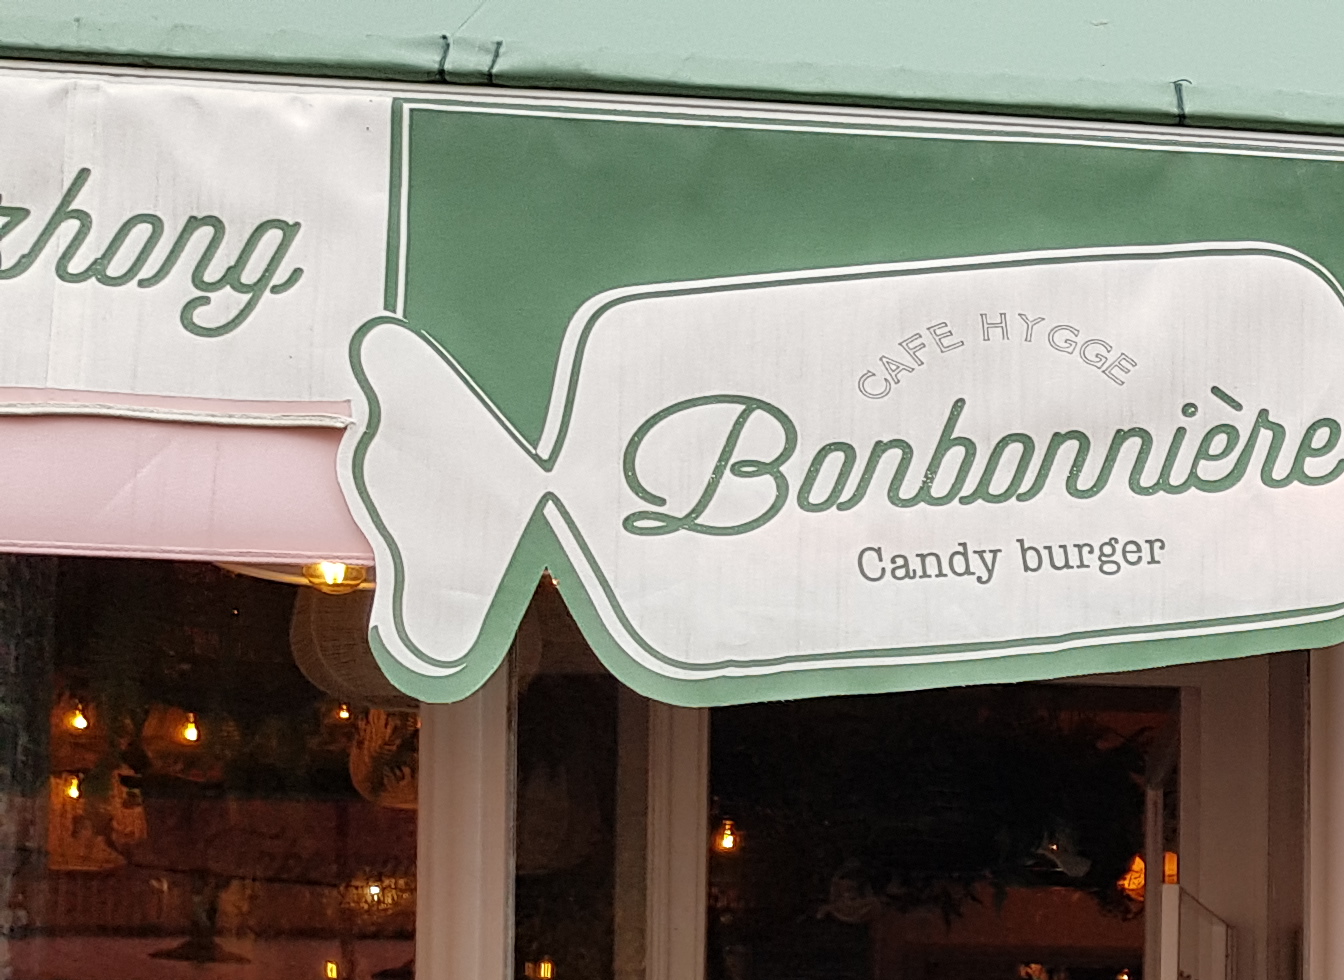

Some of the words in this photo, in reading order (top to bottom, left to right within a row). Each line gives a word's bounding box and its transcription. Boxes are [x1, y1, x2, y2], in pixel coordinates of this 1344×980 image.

[857, 320, 965, 400] CAFE
[979, 311, 1138, 387] HYGGE
[856, 543, 1003, 586] Candy
[1017, 535, 1167, 578] burger
